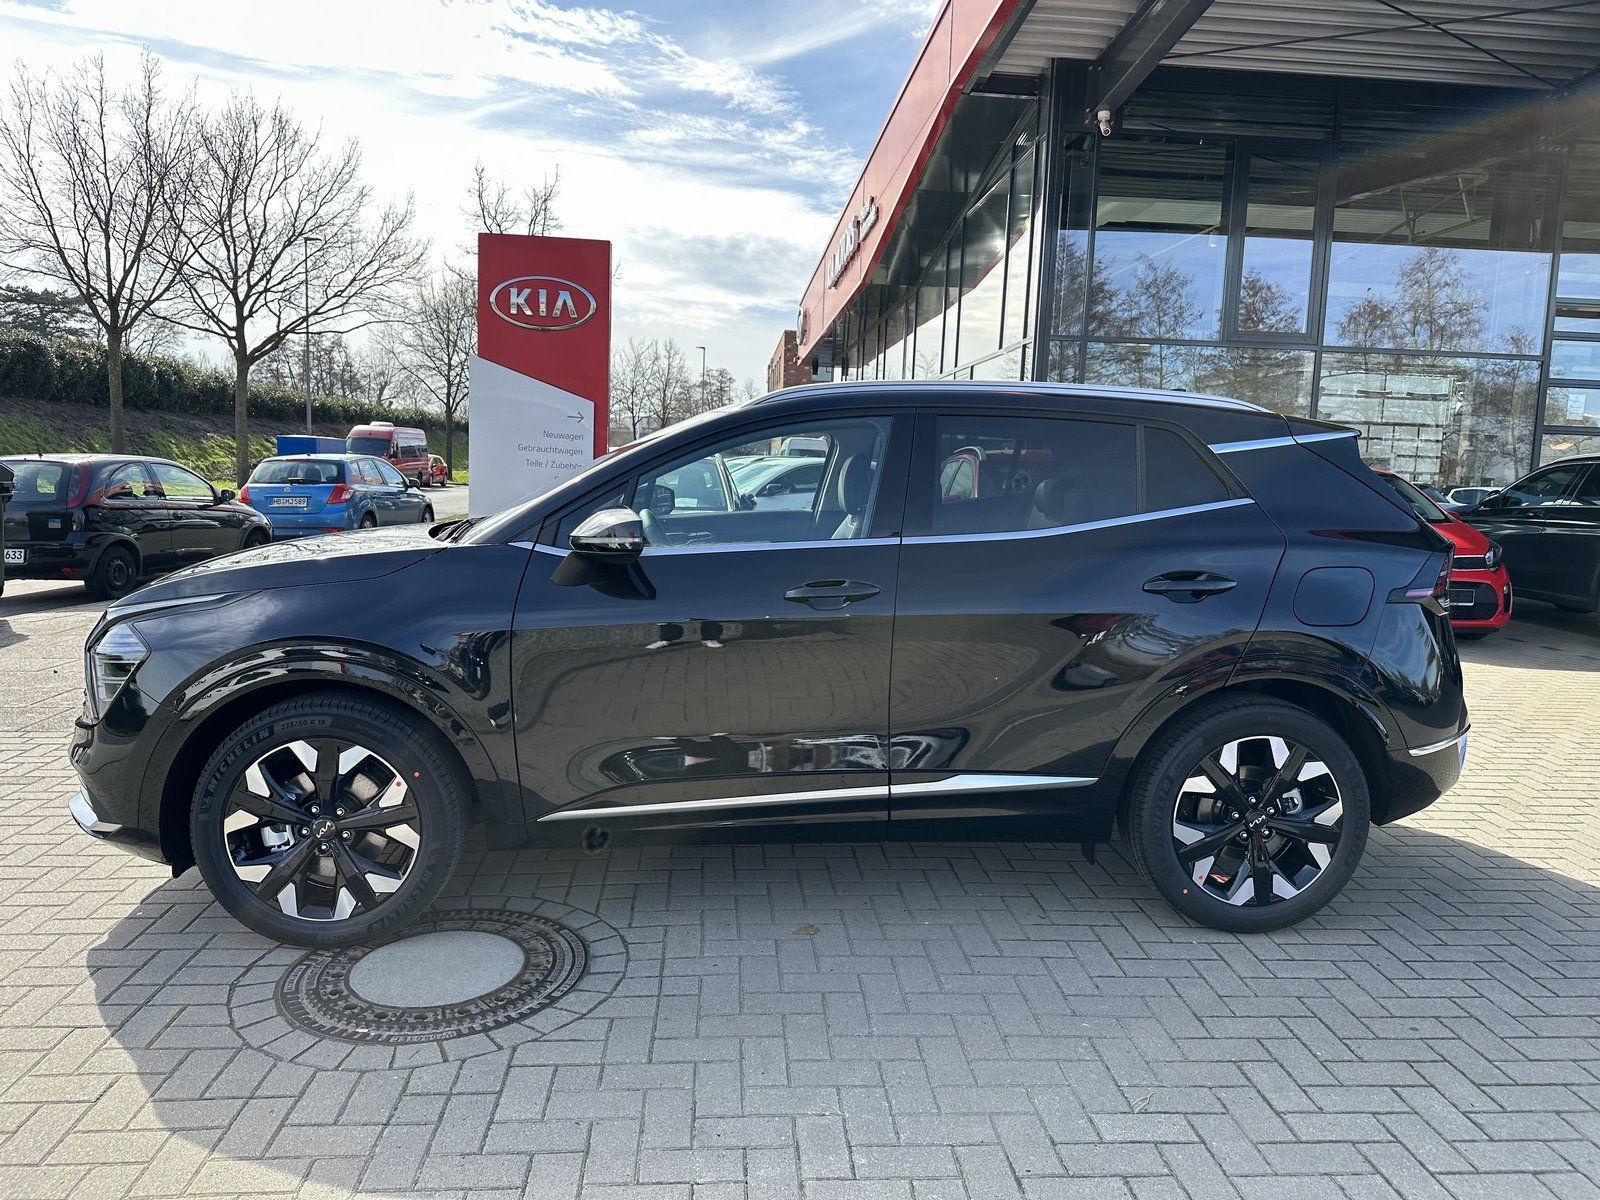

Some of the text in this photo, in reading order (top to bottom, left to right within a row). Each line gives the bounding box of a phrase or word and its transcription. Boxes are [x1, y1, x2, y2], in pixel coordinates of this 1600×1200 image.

[509, 287, 578, 318] KIA
[543, 430, 584, 441] Neuwagen
[517, 443, 583, 456] Gebrauchtwagen
[525, 459, 543, 468] Teile
[5, 550, 23, 560] 633
[206, 727, 272, 795] MICHELIN
